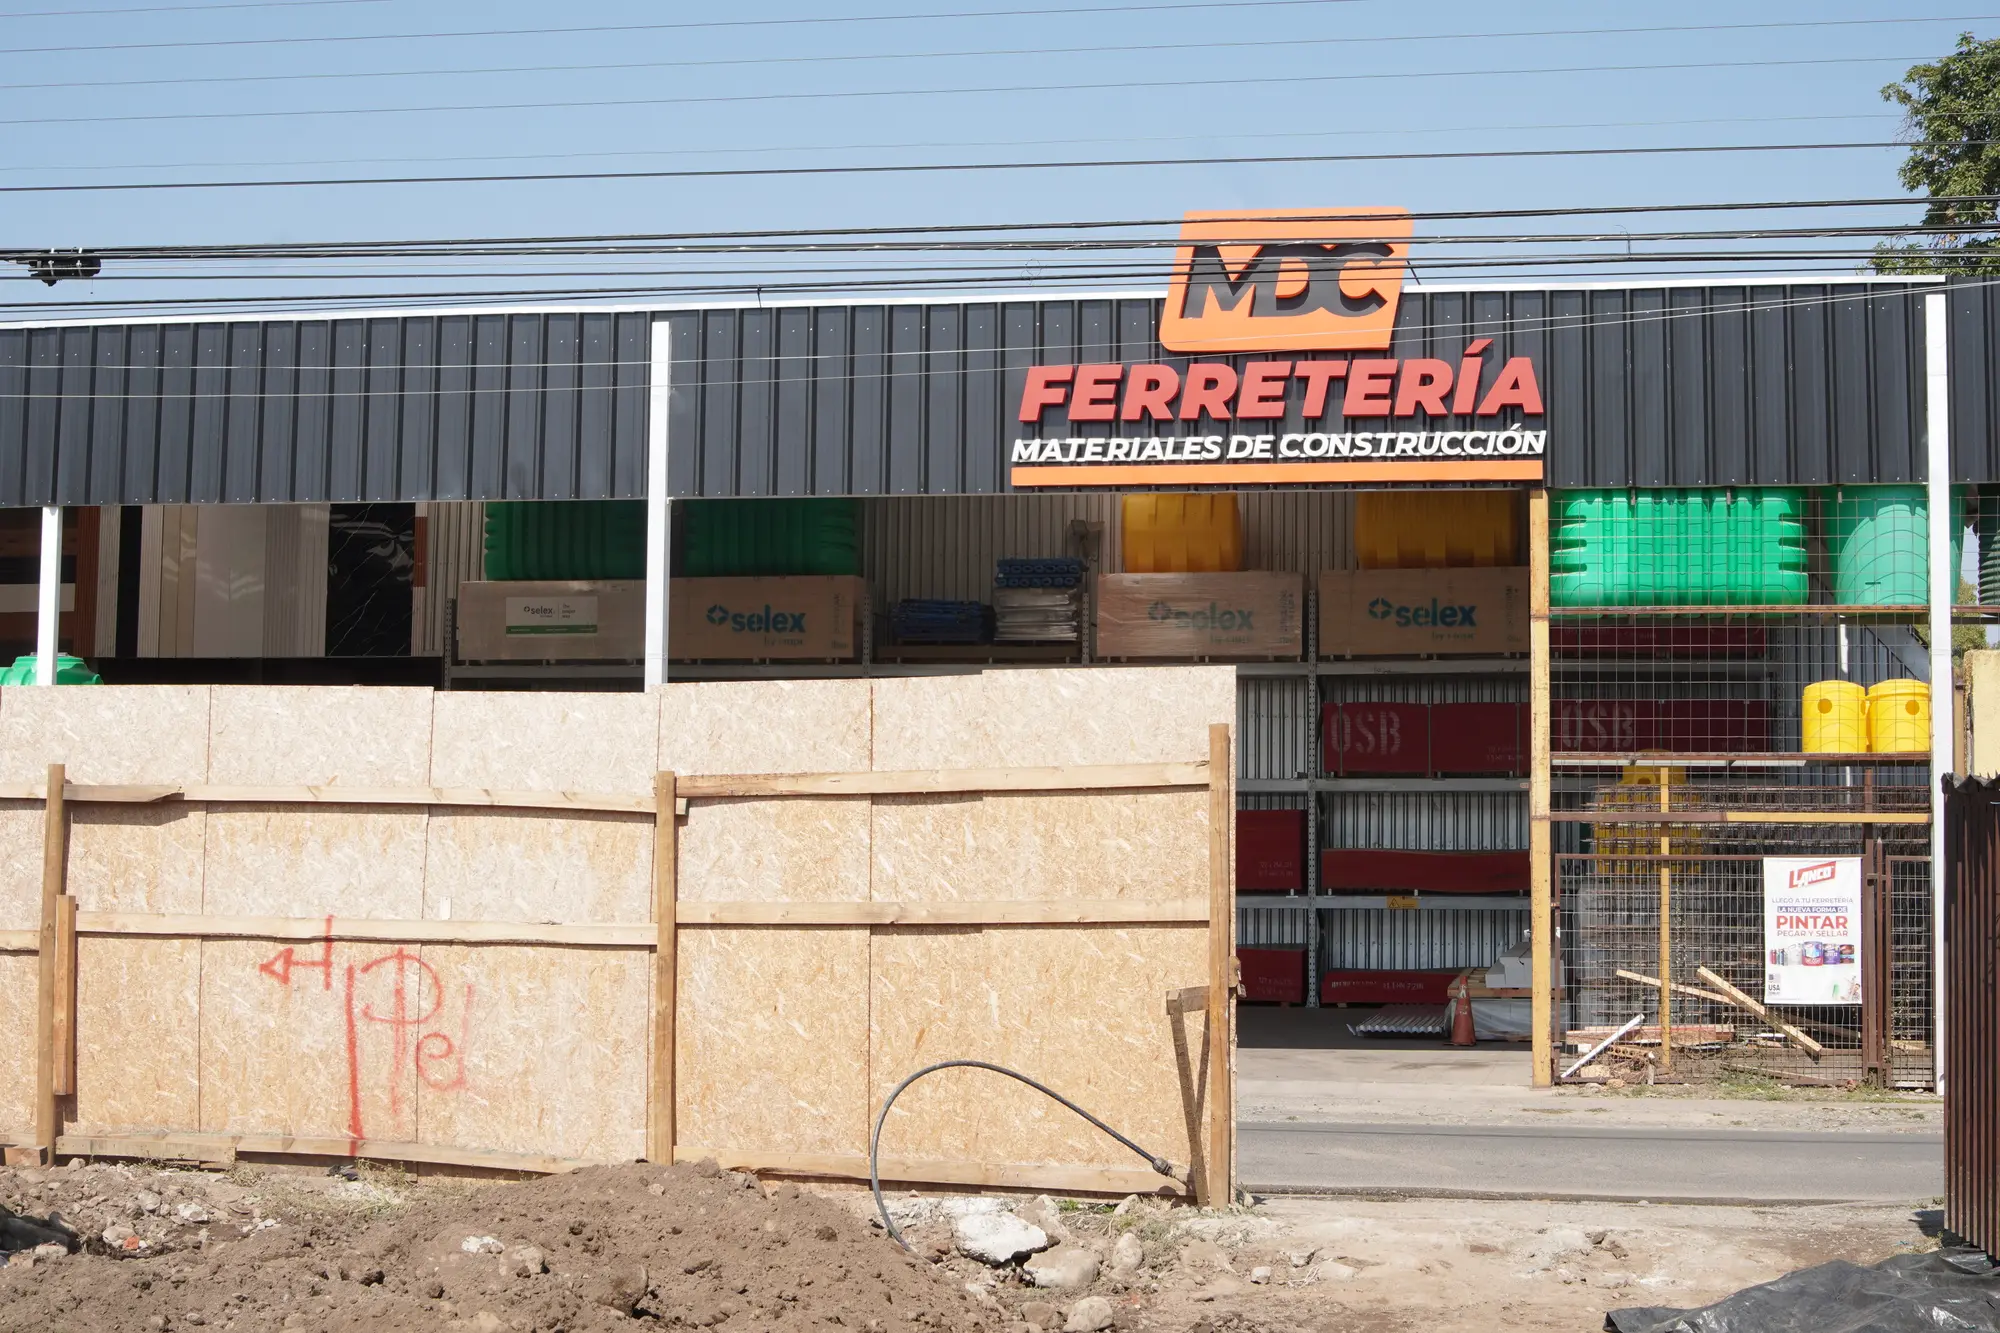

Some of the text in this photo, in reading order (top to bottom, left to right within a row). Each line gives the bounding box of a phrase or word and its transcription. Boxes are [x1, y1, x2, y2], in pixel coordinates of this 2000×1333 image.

[1179, 242, 1395, 319] MDC
[1017, 338, 1545, 423] FERRETERÍA
[1011, 423, 1547, 463] MATERIALES DE CONSTRUCCIÓN
[530, 606, 553, 615] selex
[731, 604, 806, 633] selex
[1395, 597, 1477, 627] selex
[1330, 710, 1402, 756] OSB
[1562, 703, 1634, 749] OSB
[1793, 866, 1832, 888] LANCO
[1776, 915, 1848, 929] PINTAR
